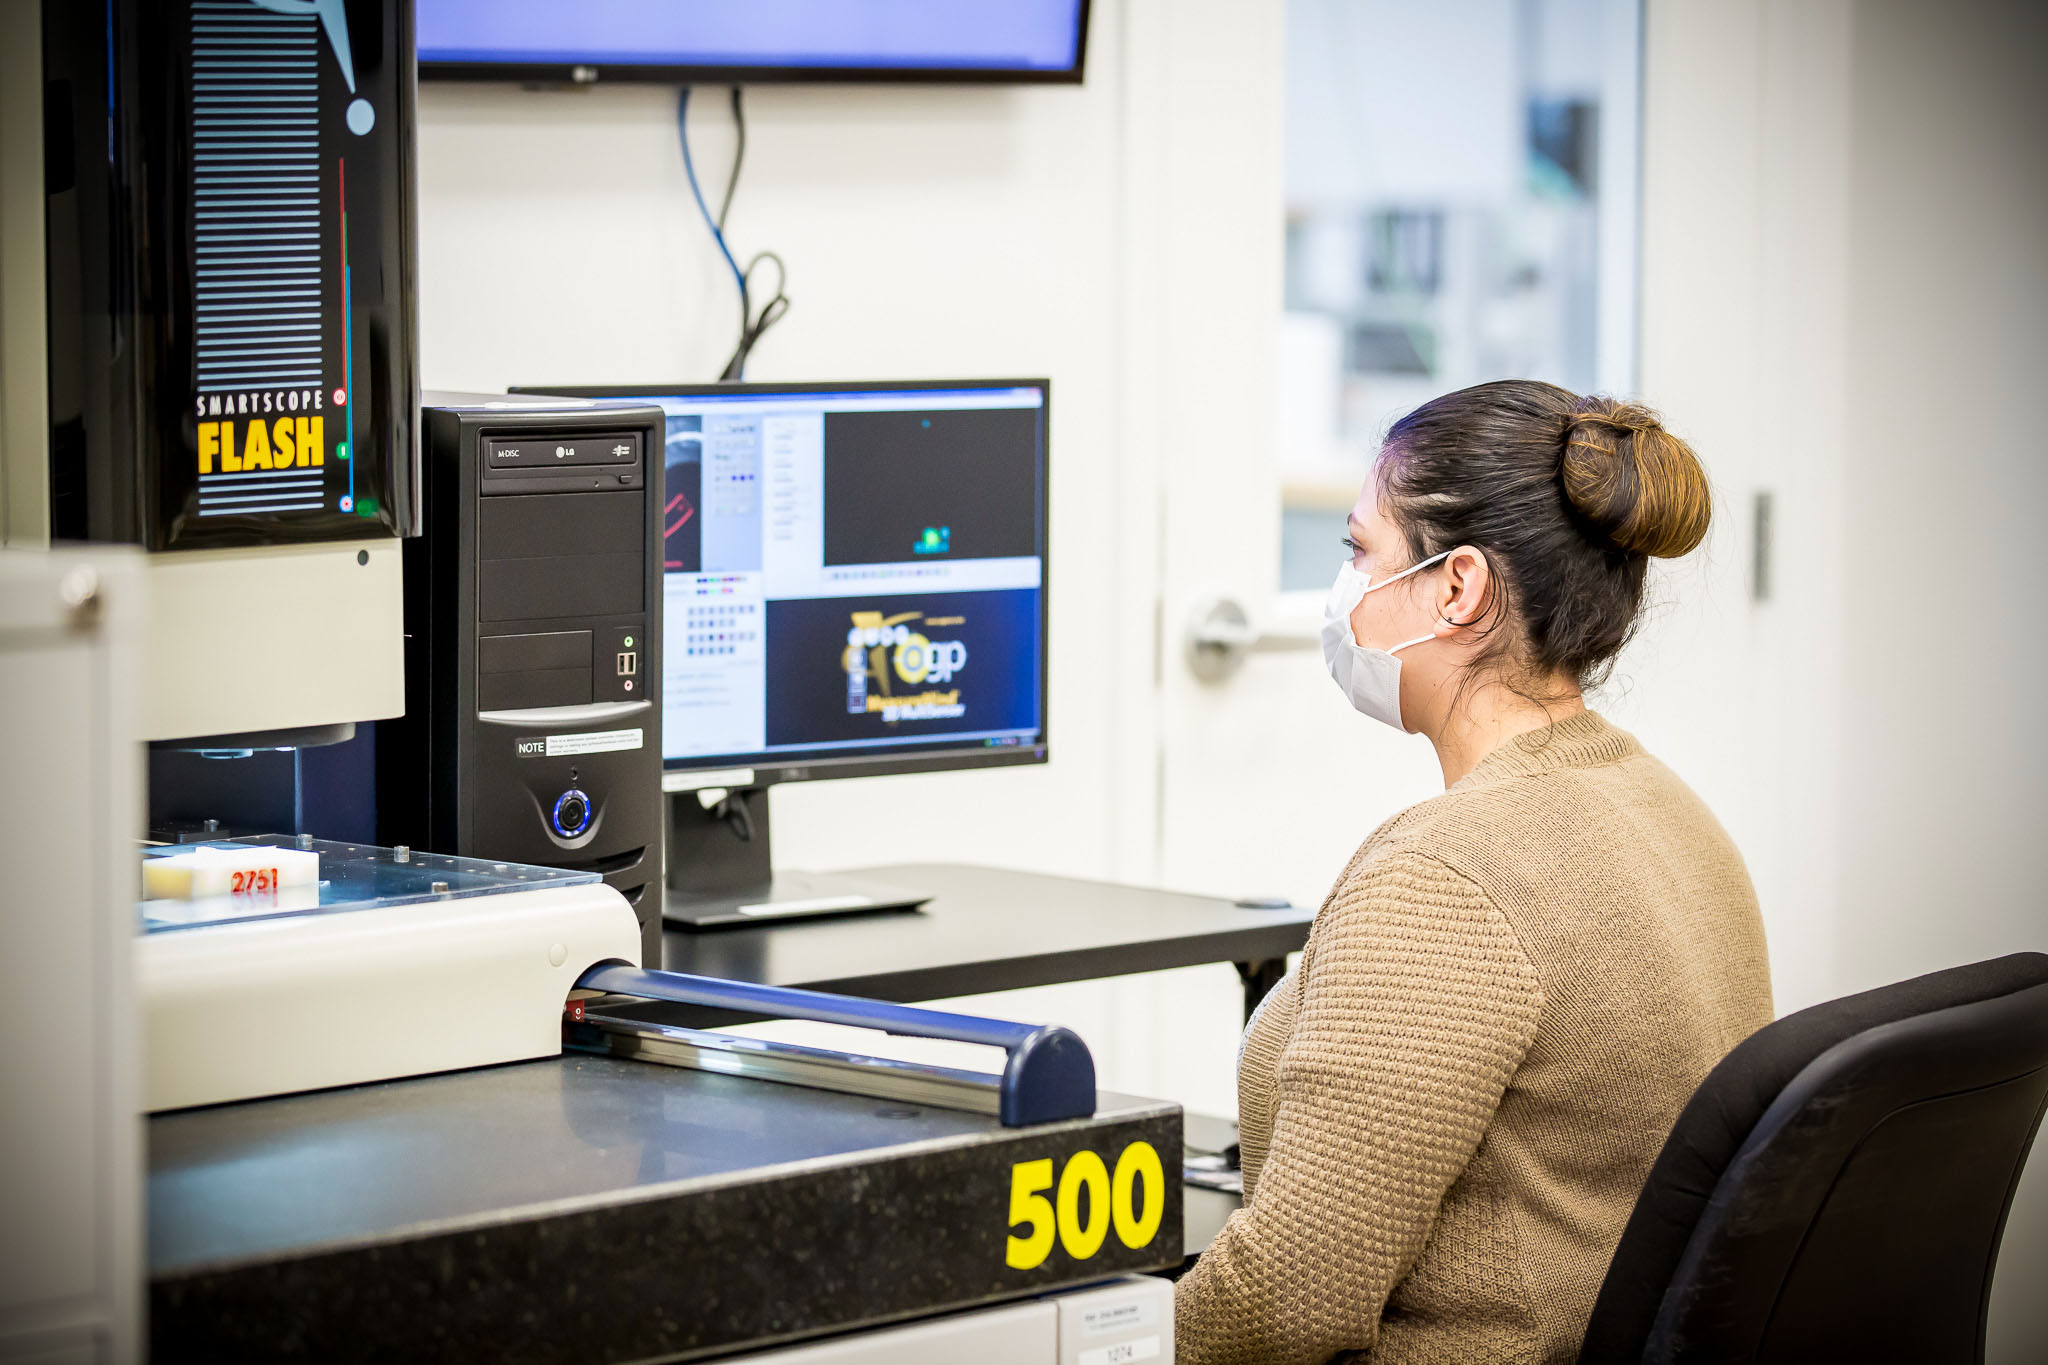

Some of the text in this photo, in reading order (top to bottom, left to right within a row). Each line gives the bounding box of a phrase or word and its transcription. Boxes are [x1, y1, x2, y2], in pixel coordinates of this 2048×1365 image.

[196, 389, 323, 417] SMARTSCOPE
[197, 415, 325, 474] FLASH
[518, 742, 545, 754] NOTE
[231, 868, 278, 893] 2751
[1005, 1141, 1165, 1271] 500
